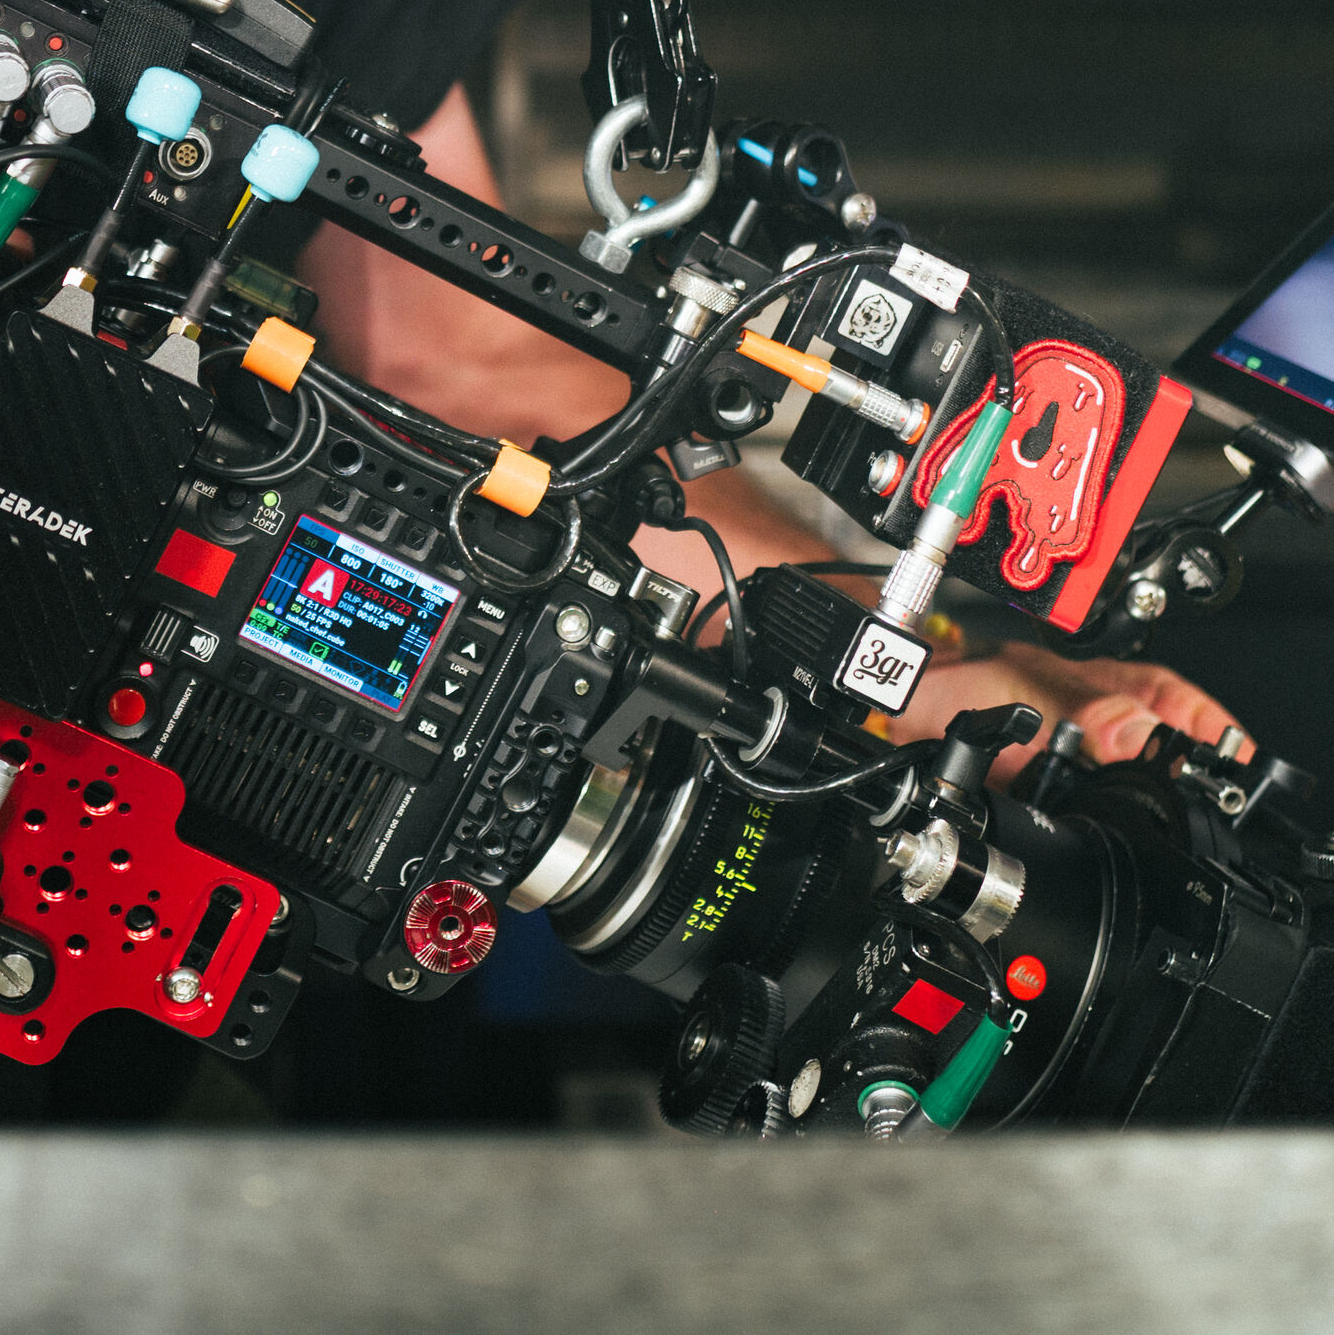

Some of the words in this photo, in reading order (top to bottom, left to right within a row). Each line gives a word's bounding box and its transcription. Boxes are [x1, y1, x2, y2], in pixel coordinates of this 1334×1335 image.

[148, 188, 169, 205] Aux
[195, 481, 216, 496] PWR
[263, 508, 278, 520] ON
[258, 518, 277, 532] OFF
[304, 535, 318, 549] 50
[351, 543, 365, 555] ISO
[340, 554, 362, 571] 800
[380, 557, 416, 581] SHUTTER
[307, 569, 336, 601] A
[431, 583, 445, 594] WB
[592, 574, 616, 592] EXP
[342, 591, 364, 607] CLIP:
[350, 579, 413, 617] 17:29:17:23
[290, 603, 302, 615] 50
[304, 609, 317, 622] 25
[315, 615, 333, 630] FPS
[477, 599, 505, 620] MENU
[338, 614, 354, 628] HQ
[244, 628, 279, 648] PROJECT
[289, 649, 313, 666] MEDIA
[853, 639, 914, 686] 3gr
[323, 666, 360, 688] MONITOR
[450, 663, 469, 676] LOCK
[160, 732, 169, 743] DO
[165, 718, 176, 734] NOT
[172, 686, 193, 720] OBSTRUCT
[417, 720, 438, 739] SEL
[747, 803, 762, 819] 16
[389, 818, 399, 829] DO
[742, 824, 756, 840] 11
[383, 828, 394, 843] NOT
[367, 841, 387, 875] OBSTRUCT
[734, 846, 747, 860] 8
[714, 860, 736, 880] 5.6
[715, 885, 724, 898] 4
[692, 898, 715, 916] 2.8
[686, 914, 706, 930] 2.1
[881, 919, 896, 965] PCS
